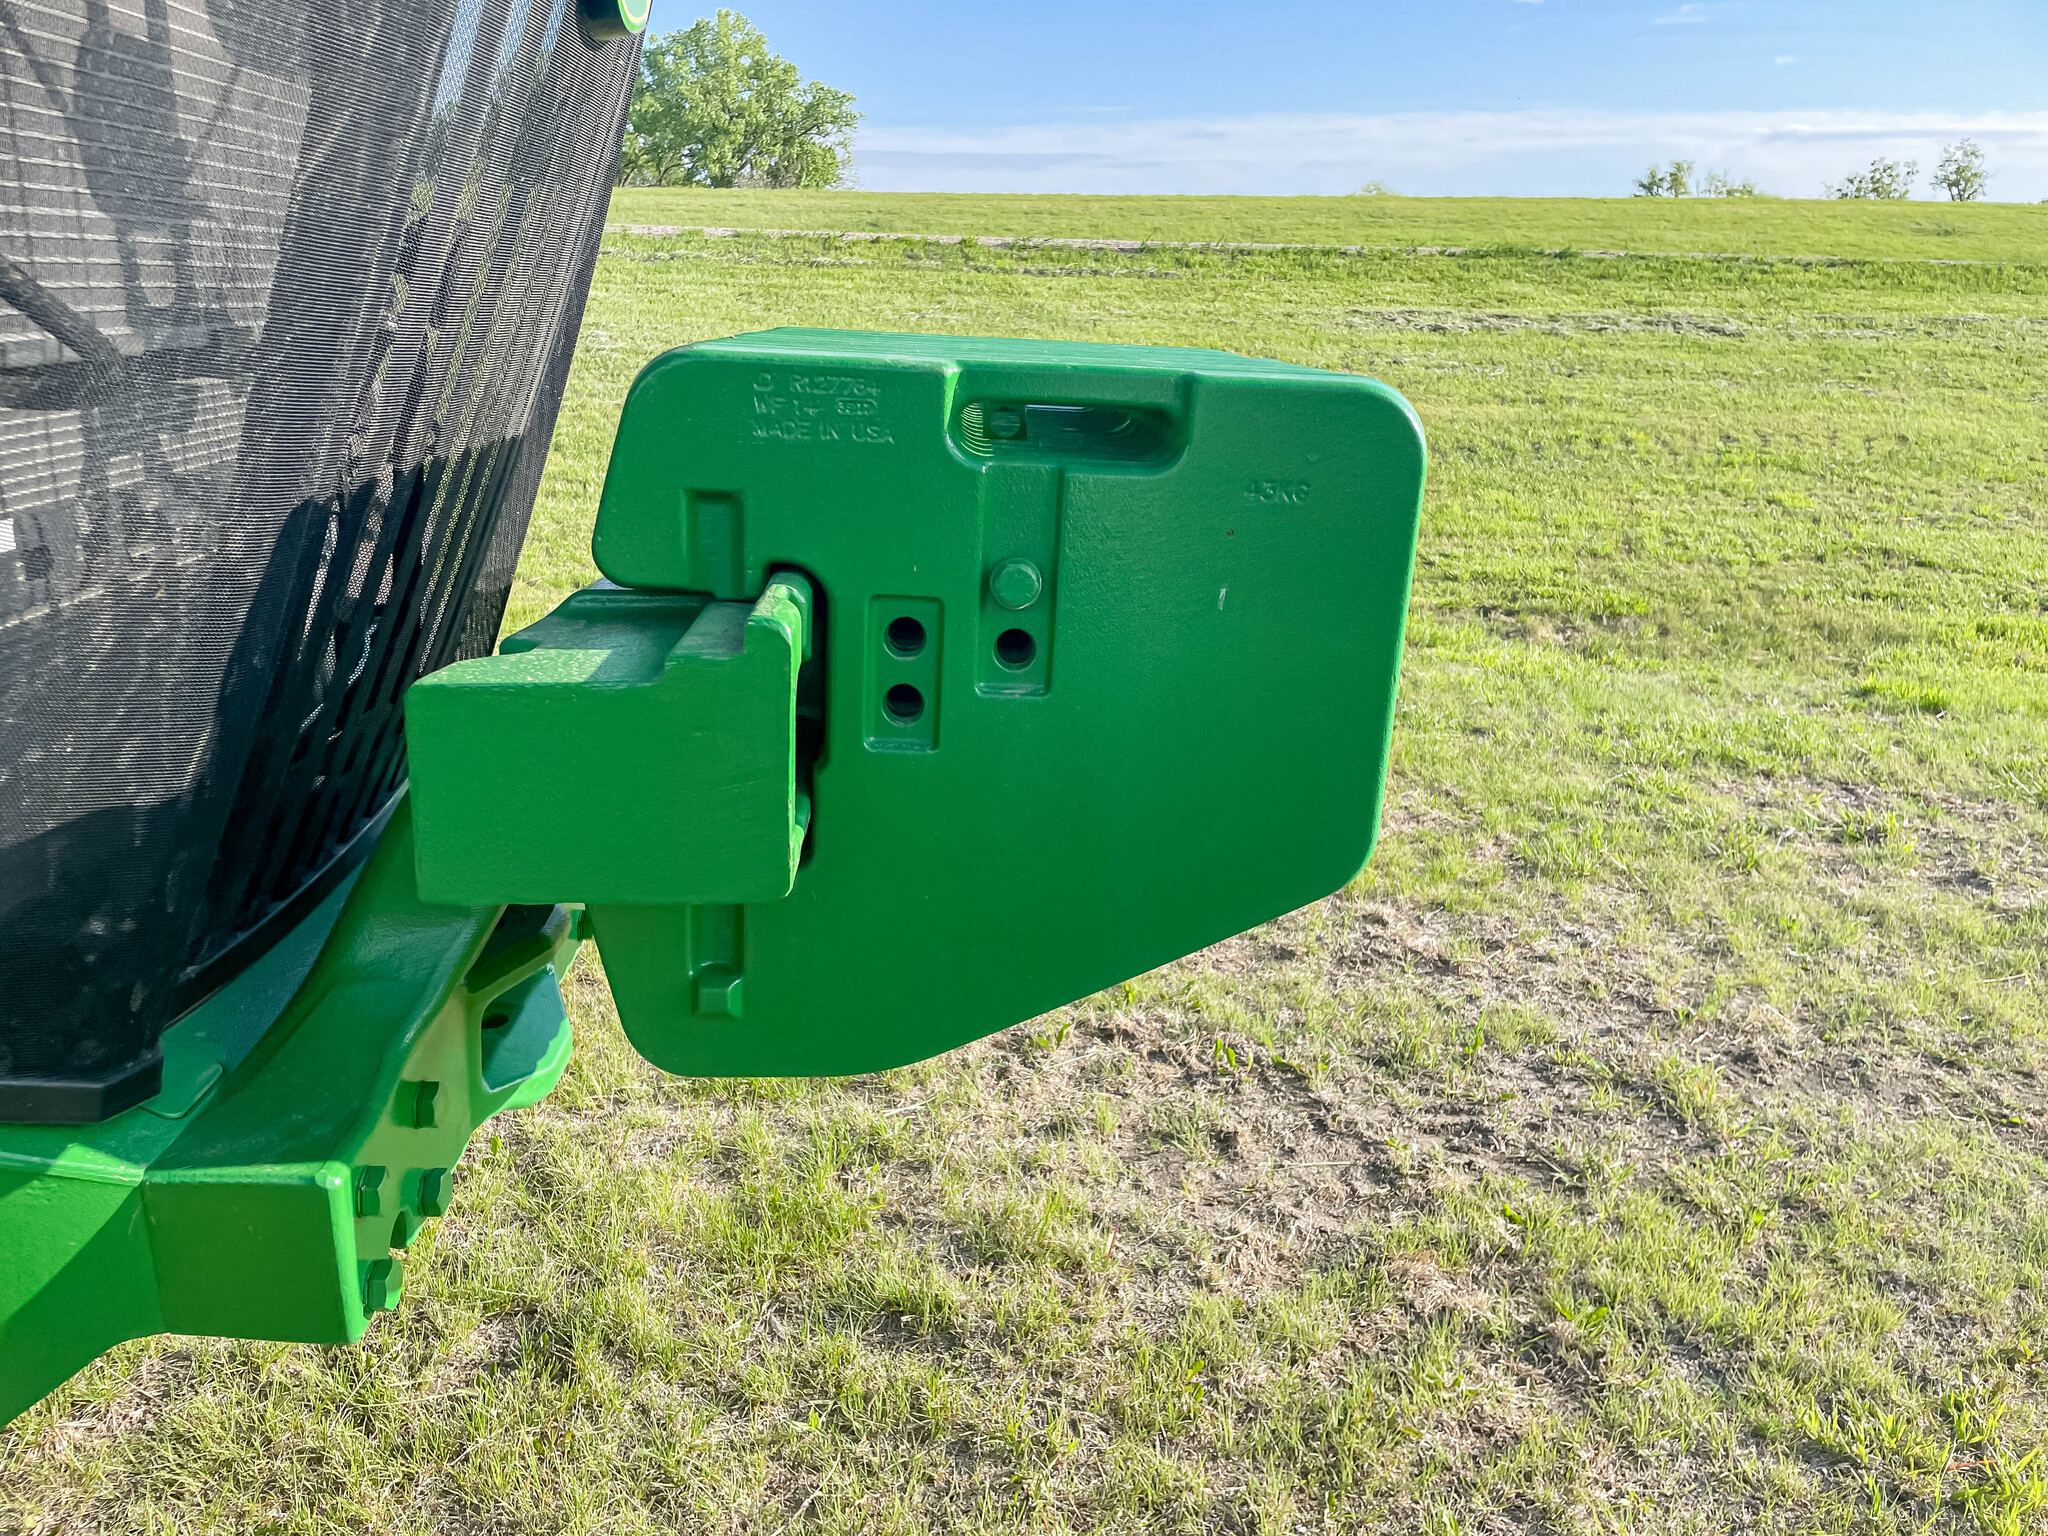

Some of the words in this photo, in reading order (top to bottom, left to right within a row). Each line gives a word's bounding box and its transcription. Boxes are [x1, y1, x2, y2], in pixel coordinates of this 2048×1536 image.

[751, 419, 812, 440] MADE
[819, 420, 841, 441] IN
[850, 422, 895, 445] USA
[1242, 479, 1311, 505] 43KG
